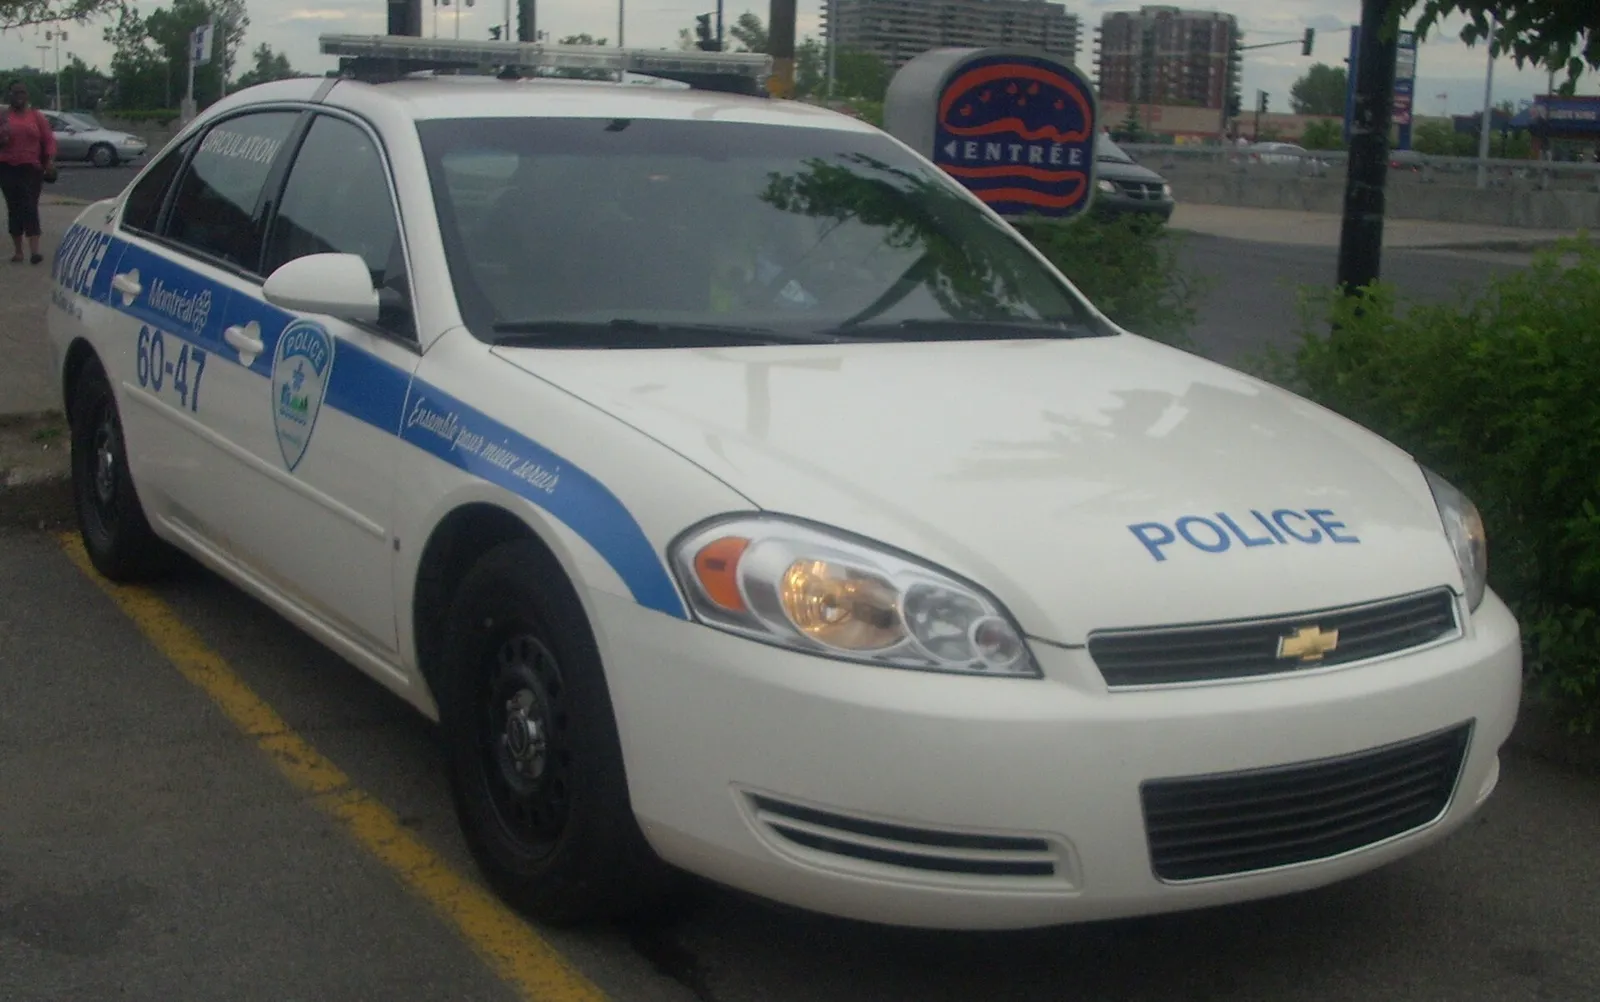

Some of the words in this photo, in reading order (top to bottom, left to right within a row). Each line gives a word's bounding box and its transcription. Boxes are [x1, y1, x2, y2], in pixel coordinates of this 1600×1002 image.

[963, 141, 1083, 166] ENTRÉE
[149, 277, 198, 323] Montréal
[136, 325, 207, 413] 60-47
[286, 332, 326, 367] POLICE
[407, 397, 459, 440] Ensemble
[450, 425, 485, 456] pour
[480, 438, 520, 471] mieux
[1126, 508, 1361, 562] POLICE
